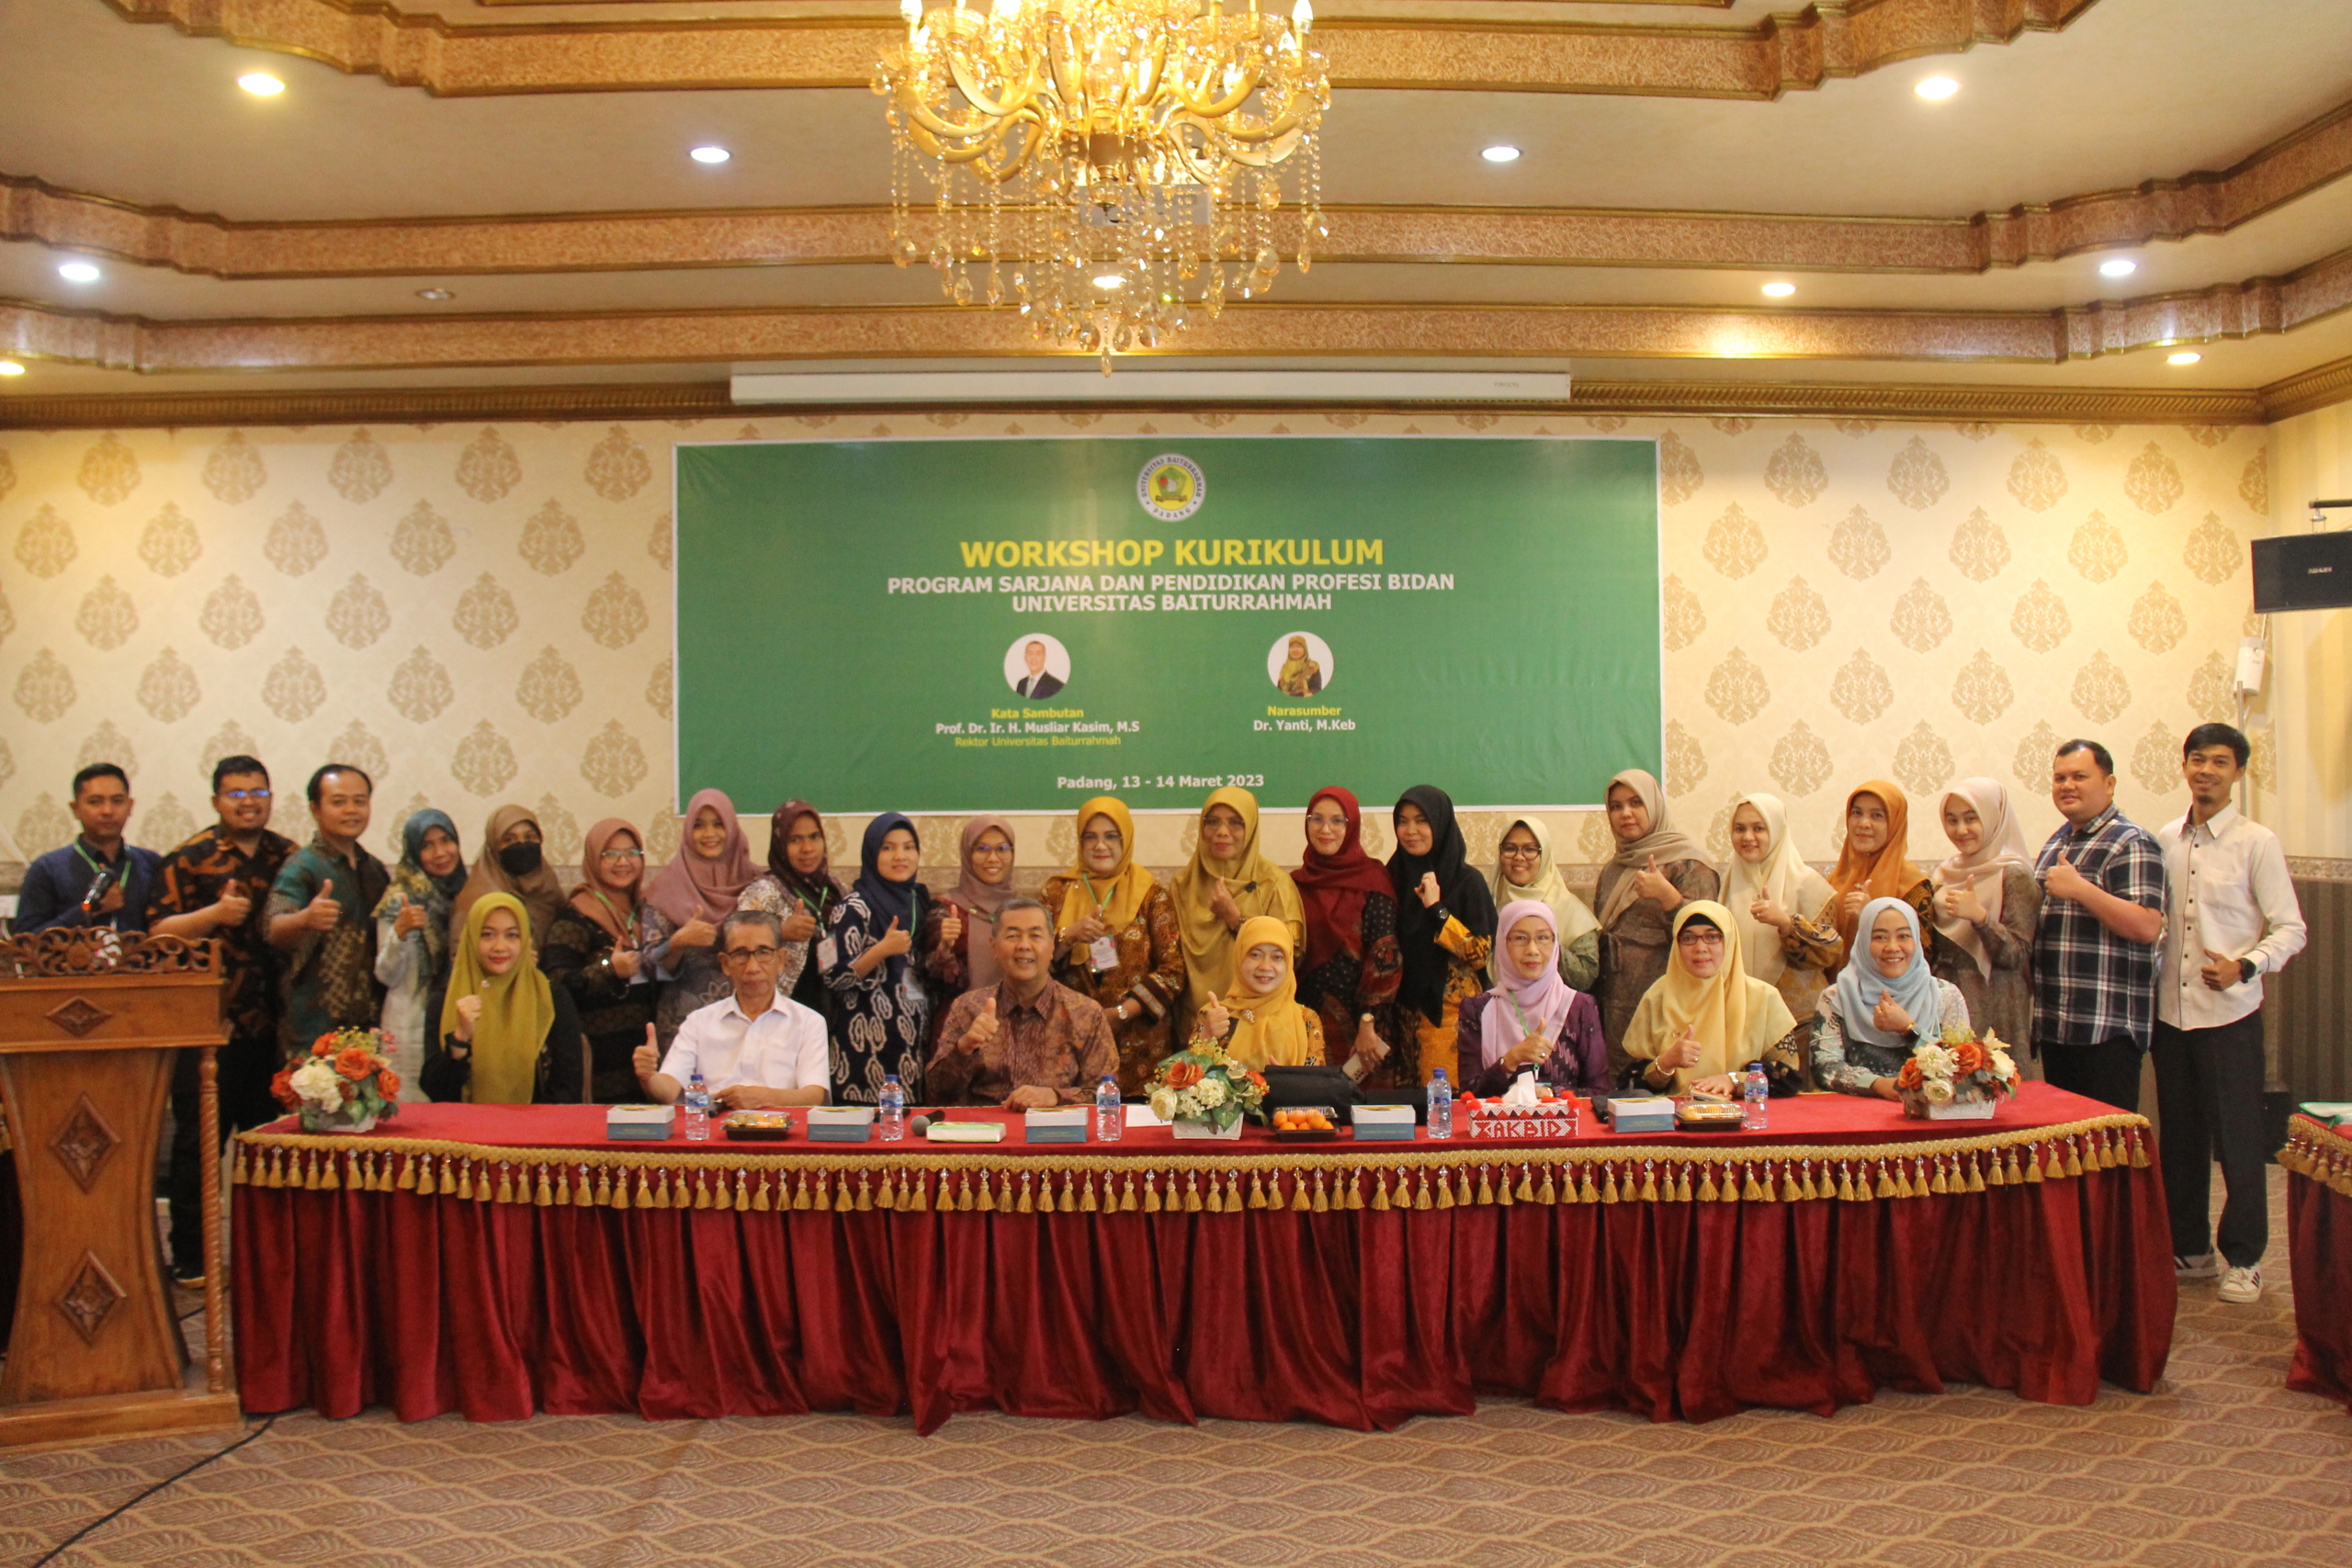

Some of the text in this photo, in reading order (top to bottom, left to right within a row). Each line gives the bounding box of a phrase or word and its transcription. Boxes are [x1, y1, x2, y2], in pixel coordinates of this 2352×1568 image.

[1153, 507, 1191, 518] PADANG
[959, 538, 1384, 569] WORKSHOP KURIKULUM
[887, 573, 1454, 594] PROGRAM SARJANA DAN PENDIDIKAN PROFESI BIDAN
[1012, 592, 1332, 613] UNIVERSITAS BAITURRAHMAH
[990, 707, 1085, 719] Kata Sambutan
[1267, 705, 1342, 716] Narasumber
[934, 720, 1140, 736] Prof. Dr. Ir. H. Musliar Kasim, M.S
[1253, 718, 1356, 734] Dr. Yanti, M.Keb
[955, 734, 1122, 748] Rektor Universitas Baiturrahmah
[1057, 775, 1118, 792] Padang,
[1122, 775, 1141, 788] 13
[1156, 775, 1176, 788] 14
[1178, 774, 1223, 788] Maret
[1226, 773, 1265, 787] 2023
